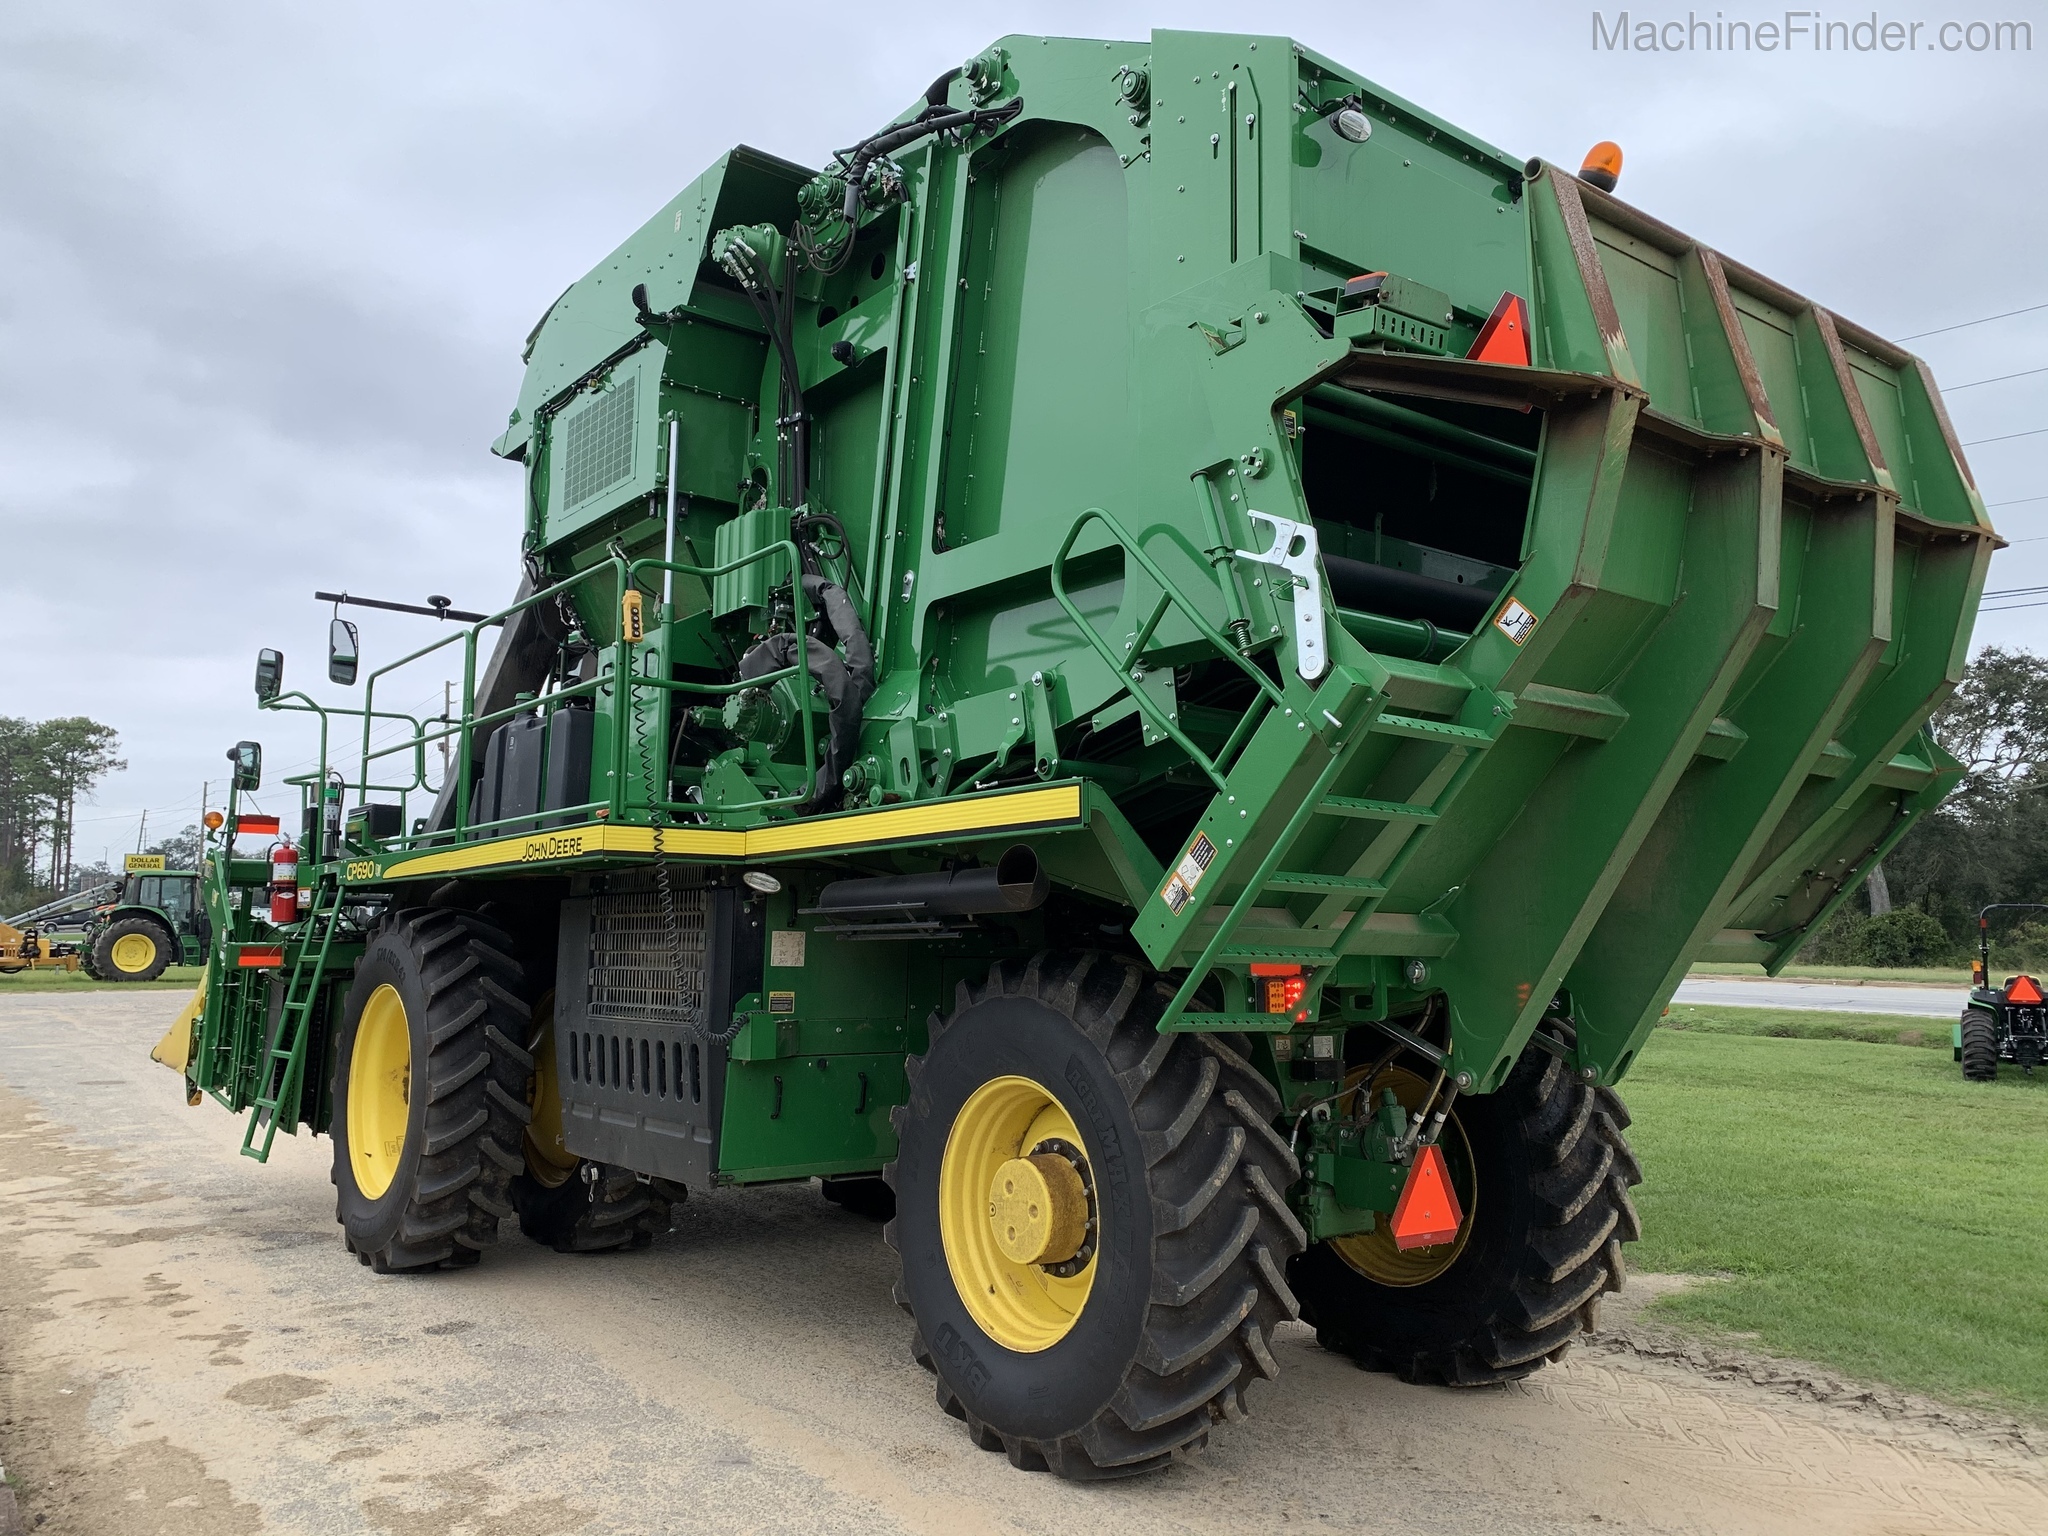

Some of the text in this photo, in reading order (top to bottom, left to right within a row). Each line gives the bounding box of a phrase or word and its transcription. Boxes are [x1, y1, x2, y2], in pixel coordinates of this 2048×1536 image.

[522, 837, 583, 860] JOHN DEERE
[346, 860, 375, 881] CP690
[935, 1330, 989, 1397] BKT
